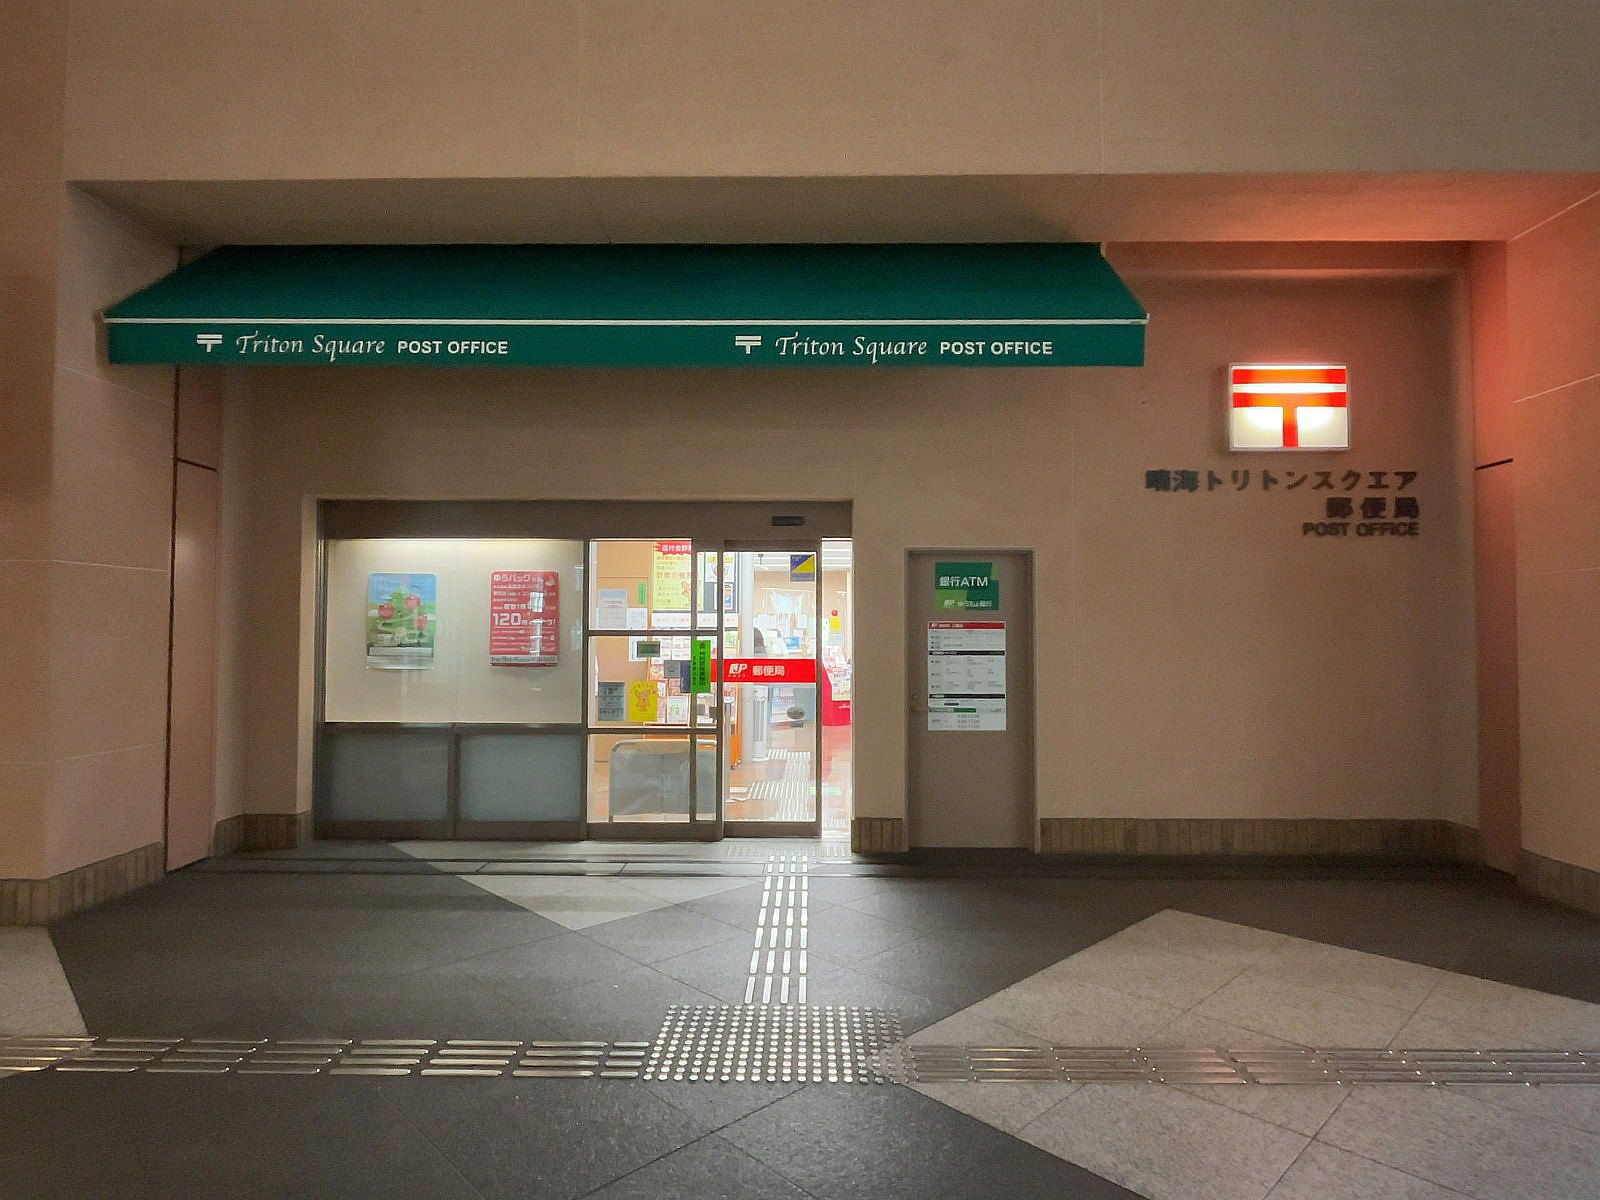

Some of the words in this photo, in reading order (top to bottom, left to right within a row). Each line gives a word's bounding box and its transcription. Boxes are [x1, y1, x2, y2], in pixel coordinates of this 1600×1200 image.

[236, 330, 304, 354] Triton
[312, 334, 385, 362] Square
[397, 341, 443, 354] POST
[447, 341, 509, 355] OFFICE
[775, 331, 845, 355] Triton
[852, 336, 928, 364] Square
[940, 341, 986, 355] POST
[990, 341, 1053, 355] OFFICE
[1145, 469, 1418, 491] 晴海トリトンスクエア
[1326, 497, 1420, 519] 郵便局
[1302, 522, 1350, 537] POST
[1355, 522, 1420, 537] OFFICE
[939, 575, 989, 587] 銀行ATM
[752, 665, 786, 677] 郵便局
